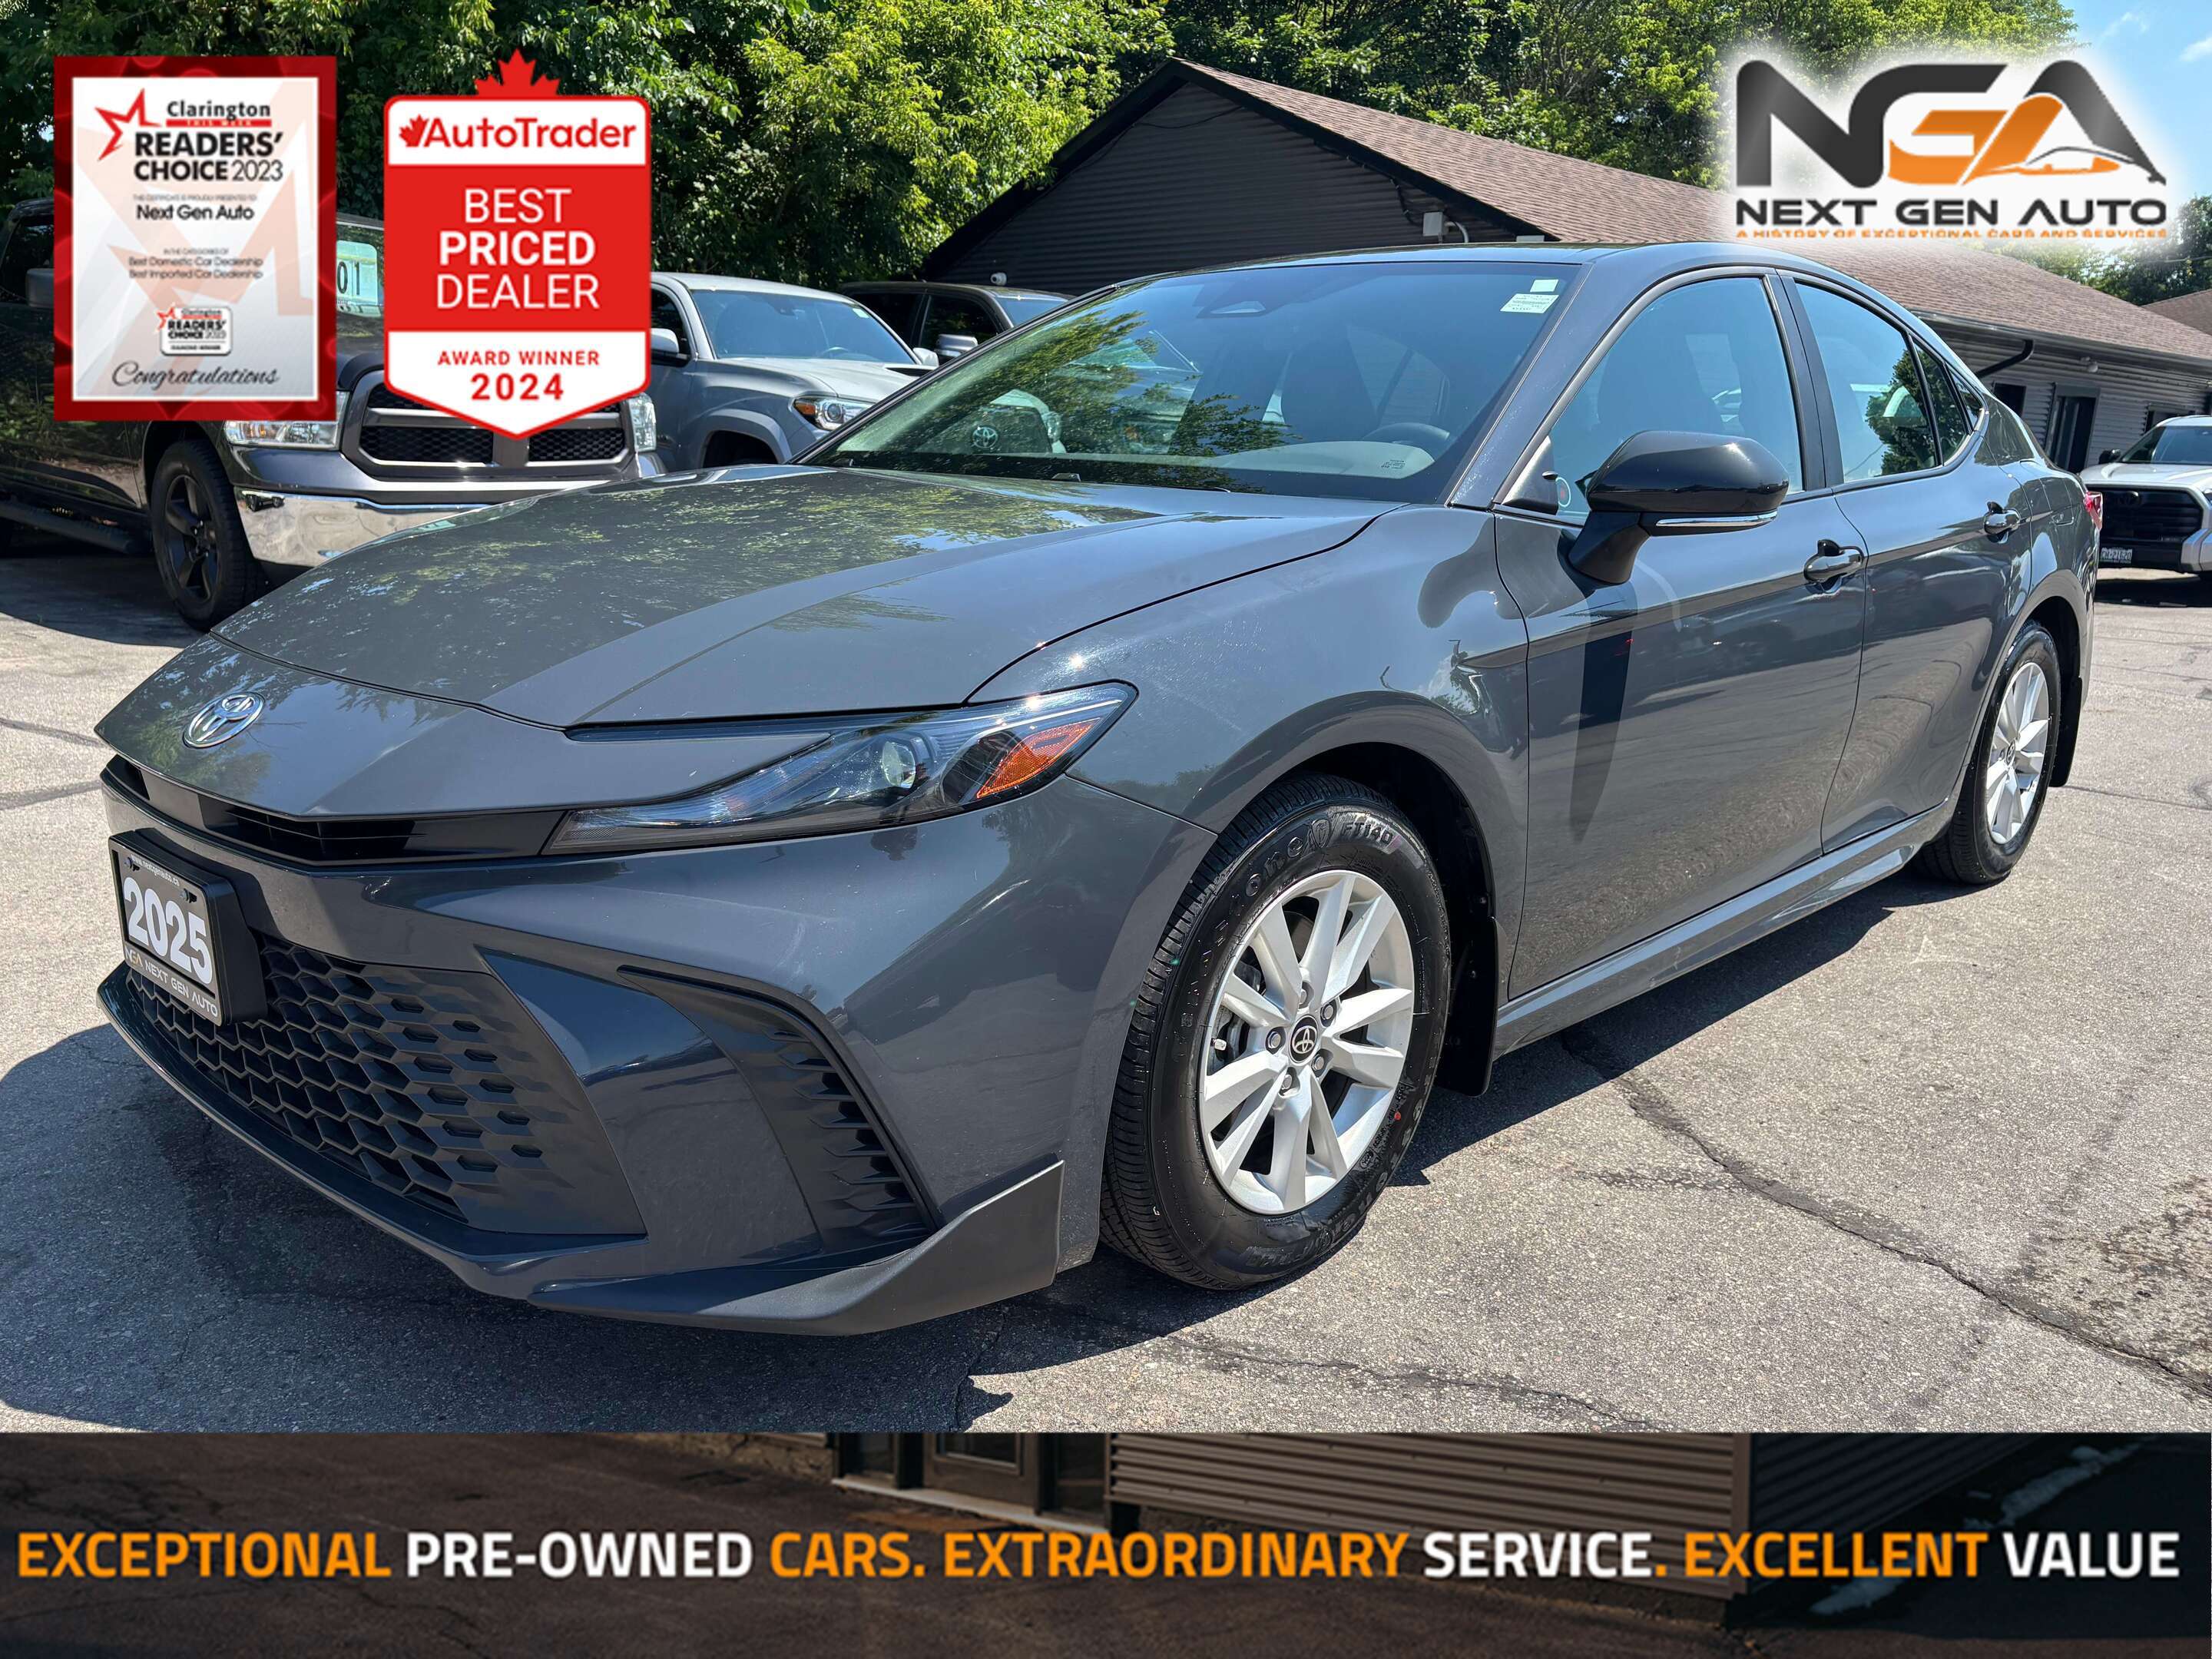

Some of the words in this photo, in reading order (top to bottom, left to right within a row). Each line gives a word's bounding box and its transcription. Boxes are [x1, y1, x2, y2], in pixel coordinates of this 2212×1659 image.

[123, 876, 213, 985] 2025
[144, 959, 168, 984] NEXT
[171, 977, 190, 998] GEN
[192, 991, 218, 1018] AUTO
